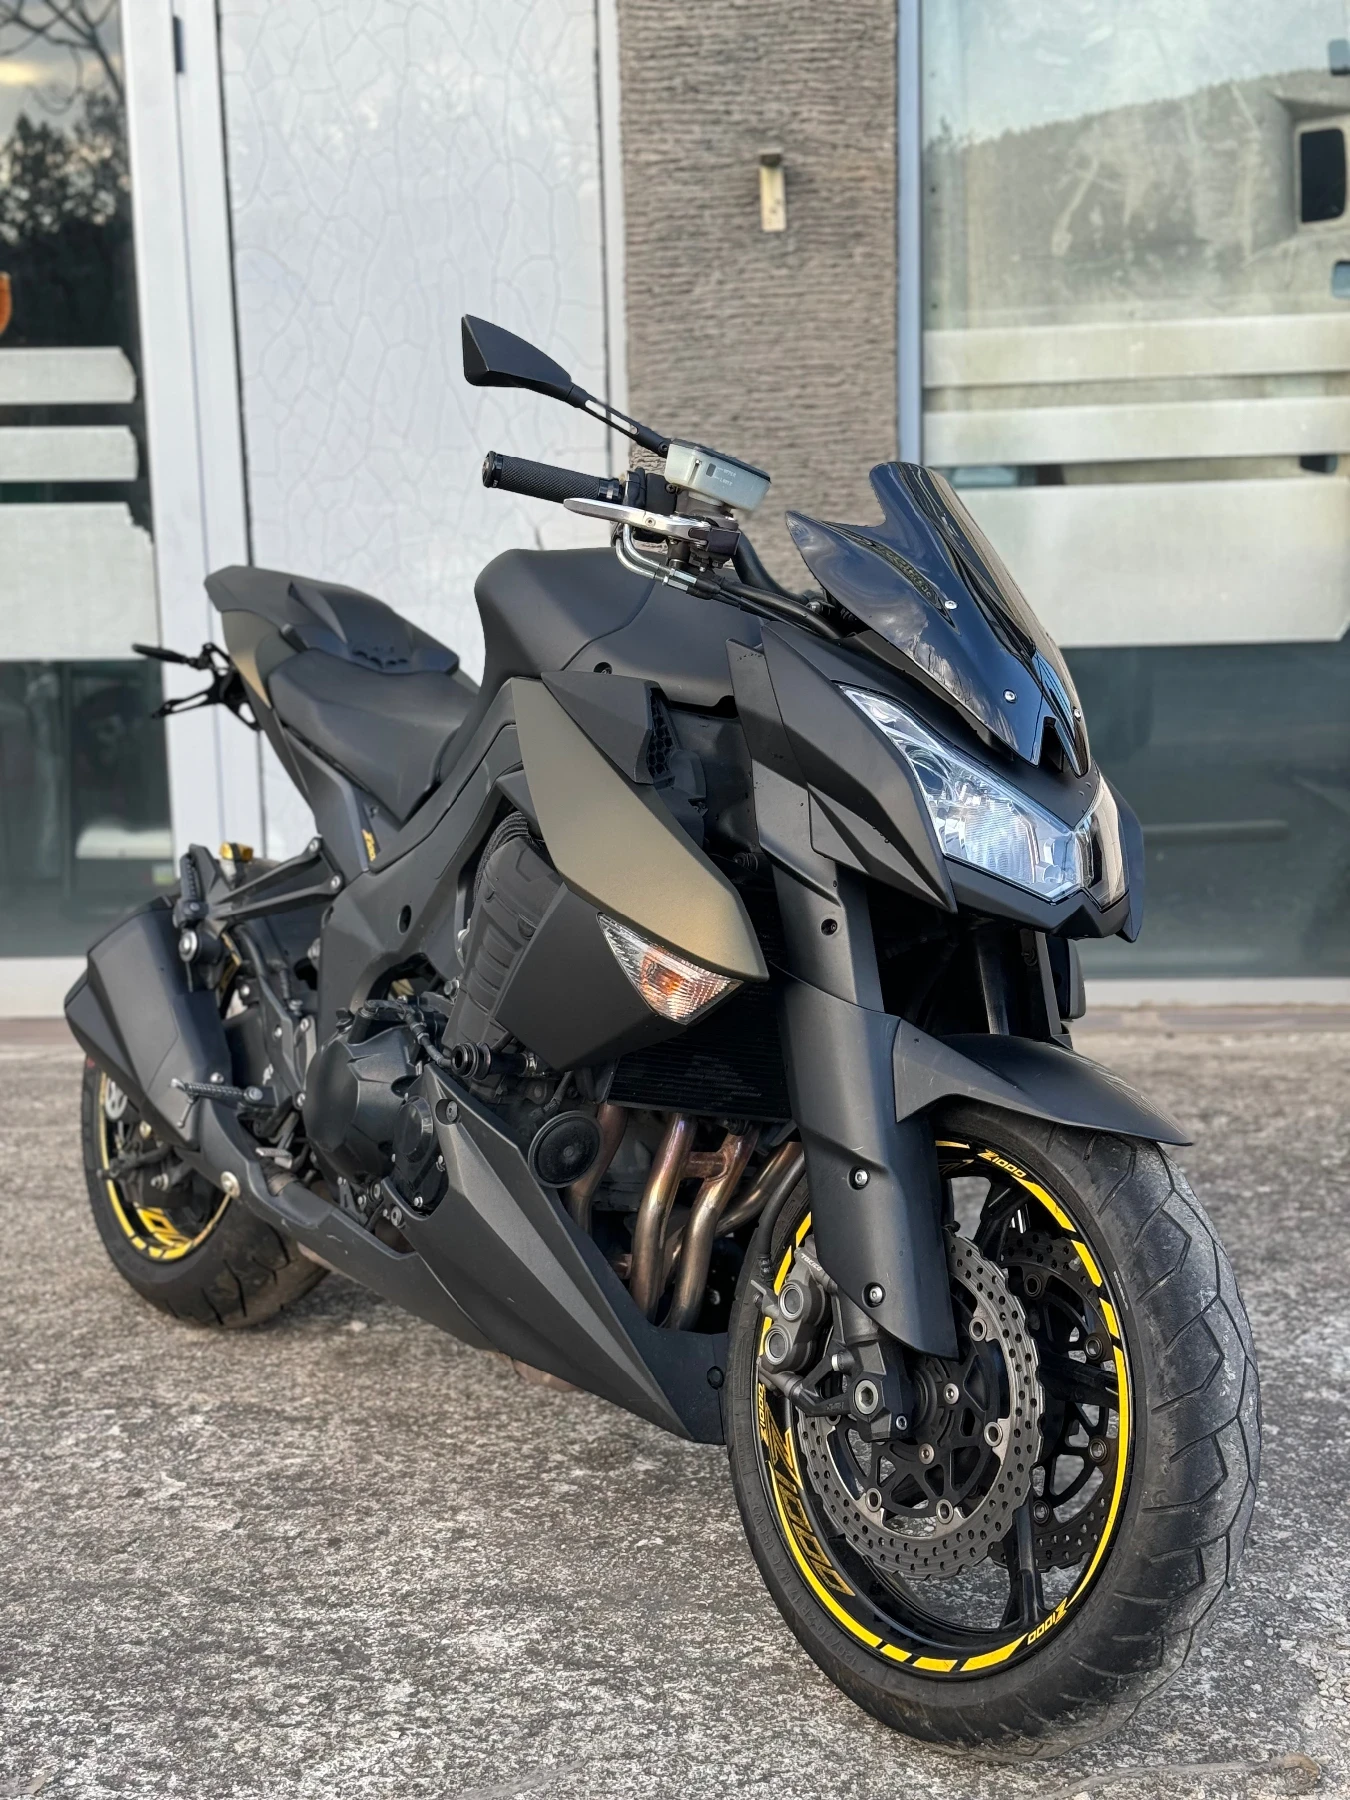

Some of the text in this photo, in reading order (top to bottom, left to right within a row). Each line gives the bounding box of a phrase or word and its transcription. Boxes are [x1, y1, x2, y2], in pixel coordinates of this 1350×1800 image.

[977, 1148, 1027, 1178] Z1000
[765, 1401, 856, 1597] Z1000
[1027, 1597, 1068, 1645] Z1000
